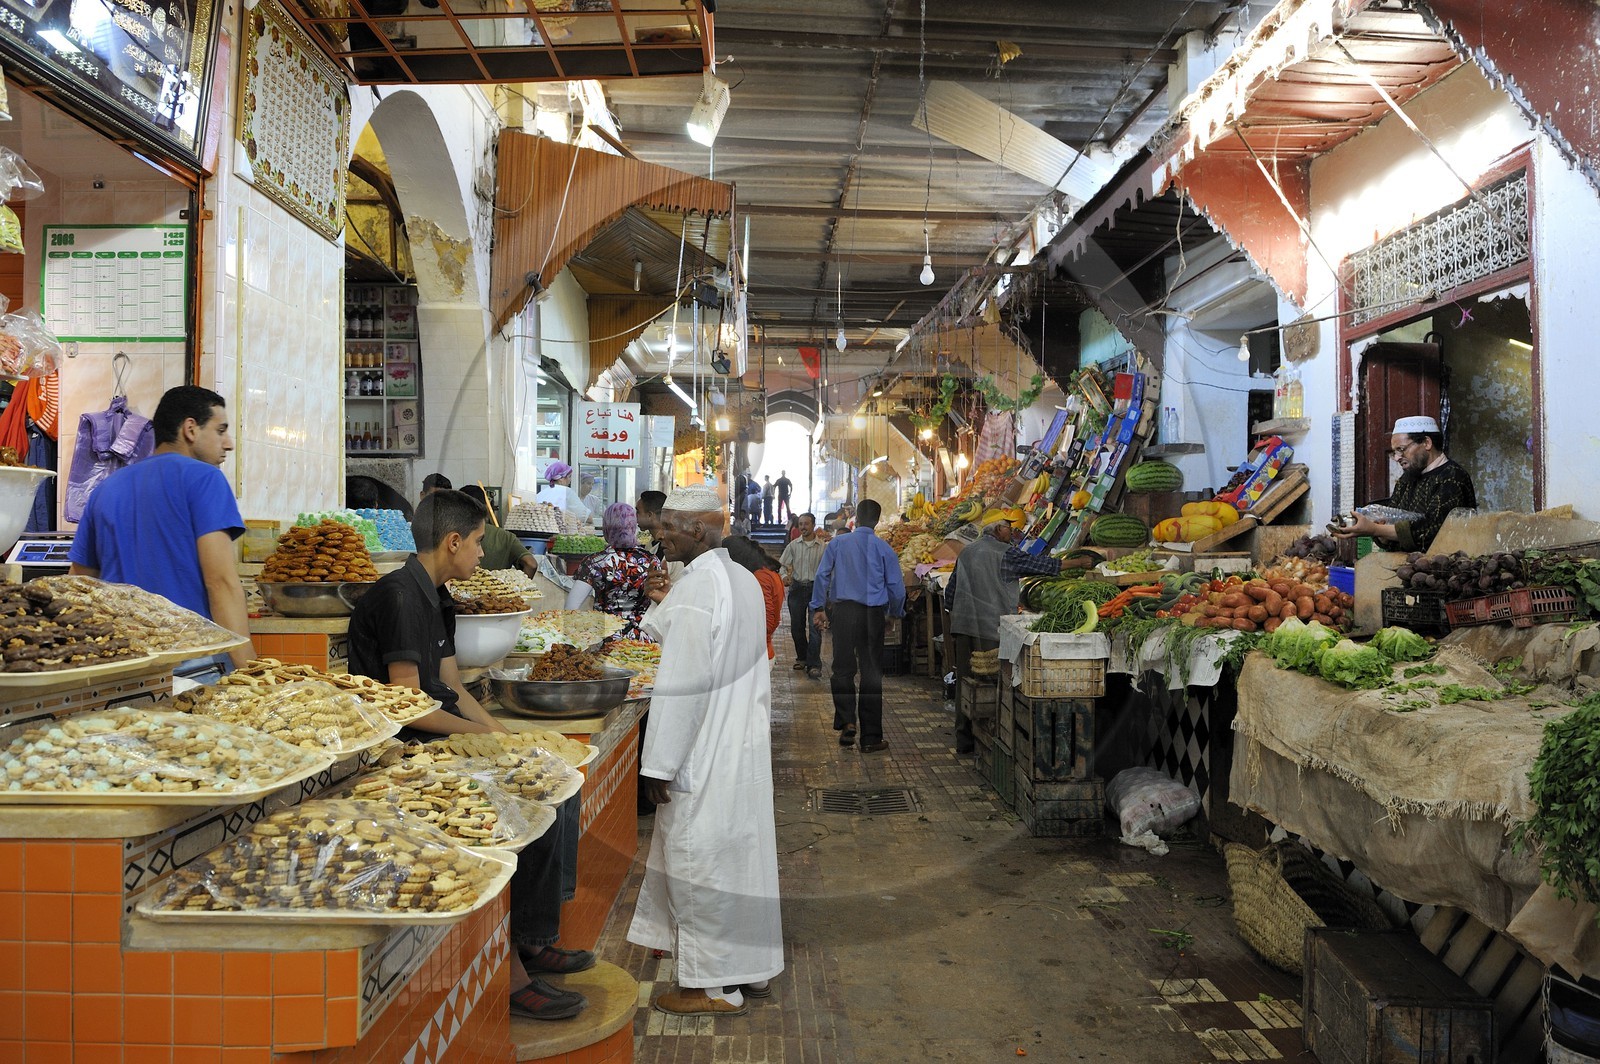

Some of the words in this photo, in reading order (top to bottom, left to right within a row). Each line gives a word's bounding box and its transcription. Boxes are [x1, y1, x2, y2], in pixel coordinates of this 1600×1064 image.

[586, 409, 611, 424] تباع
[617, 409, 634, 422] هنا
[591, 428, 628, 442] ورقة
[584, 446, 634, 462] البسطيلة
